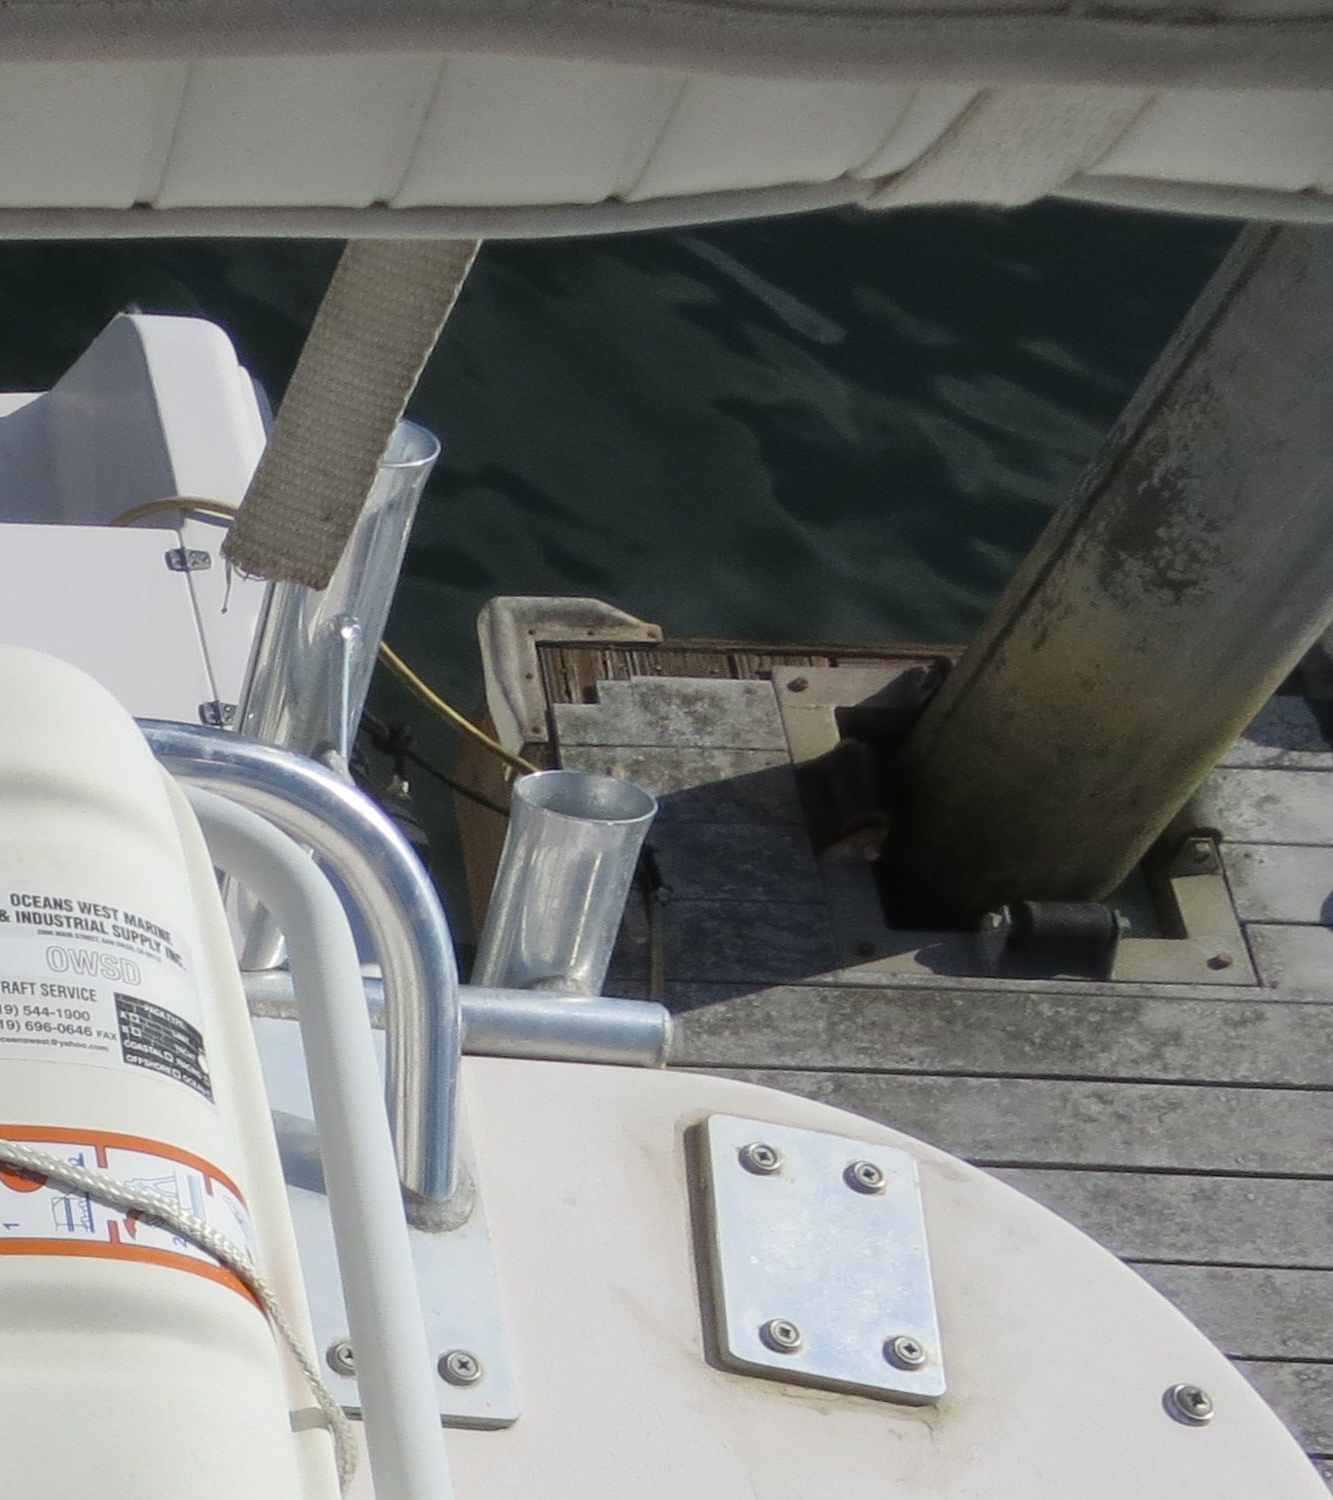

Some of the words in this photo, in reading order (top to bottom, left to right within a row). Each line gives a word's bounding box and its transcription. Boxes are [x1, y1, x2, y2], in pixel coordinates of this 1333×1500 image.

[9, 893, 74, 913] OCEANS
[78, 900, 120, 921] WEST
[123, 910, 173, 944] MARINE
[14, 910, 109, 935] INDUSTRIAL
[112, 923, 163, 953] SUPPLY
[45, 945, 141, 986] OWSD
[1, 981, 37, 998] RAFT
[40, 983, 98, 1002] SERVICE
[22, 1005, 91, 1022] 544-1900
[24, 1020, 93, 1037] 696-0646
[96, 1029, 118, 1041] FAX
[2, 1221, 20, 1230] 1
